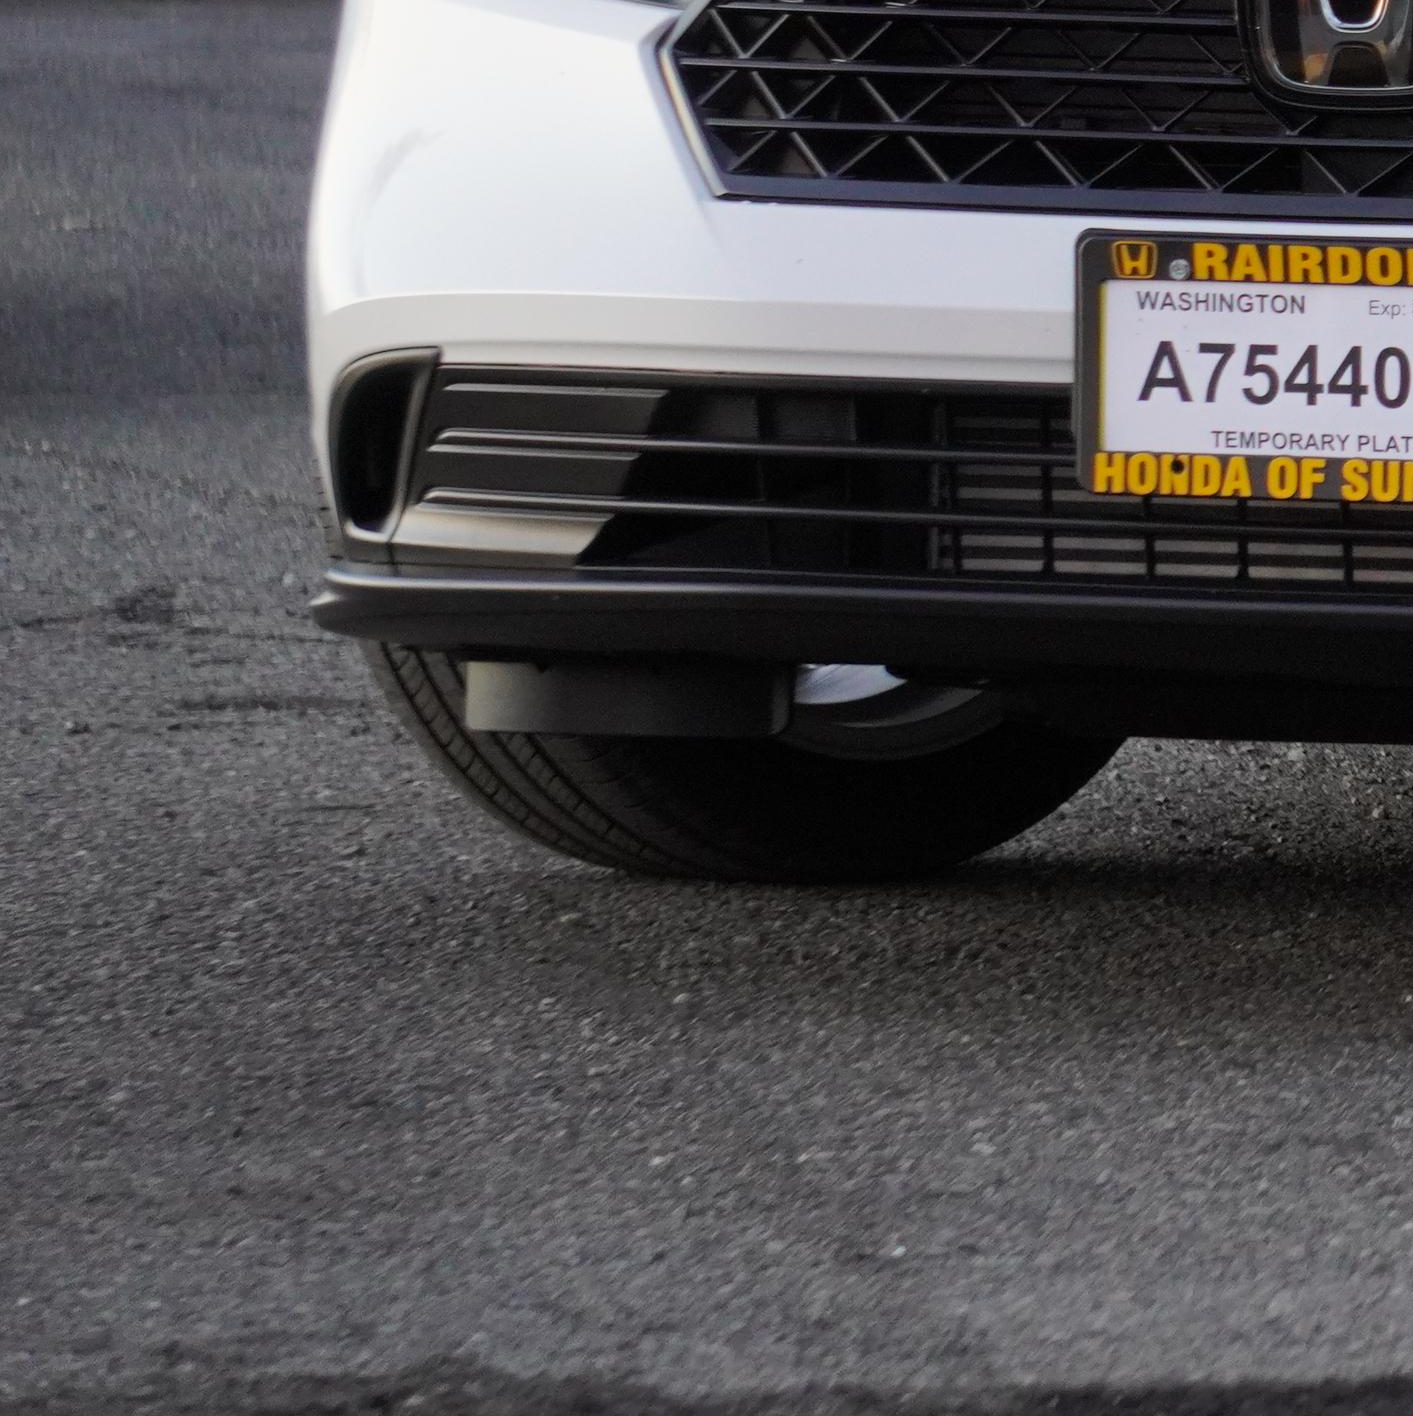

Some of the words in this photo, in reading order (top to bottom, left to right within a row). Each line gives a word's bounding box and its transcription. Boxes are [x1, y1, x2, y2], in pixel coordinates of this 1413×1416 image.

[1136, 290, 1306, 314] WASHINGTON
[1368, 299, 1407, 318] Exp:
[1211, 430, 1351, 453] TEMPORARY
[1092, 451, 1252, 498] HONDA
[1266, 459, 1328, 500] OF
